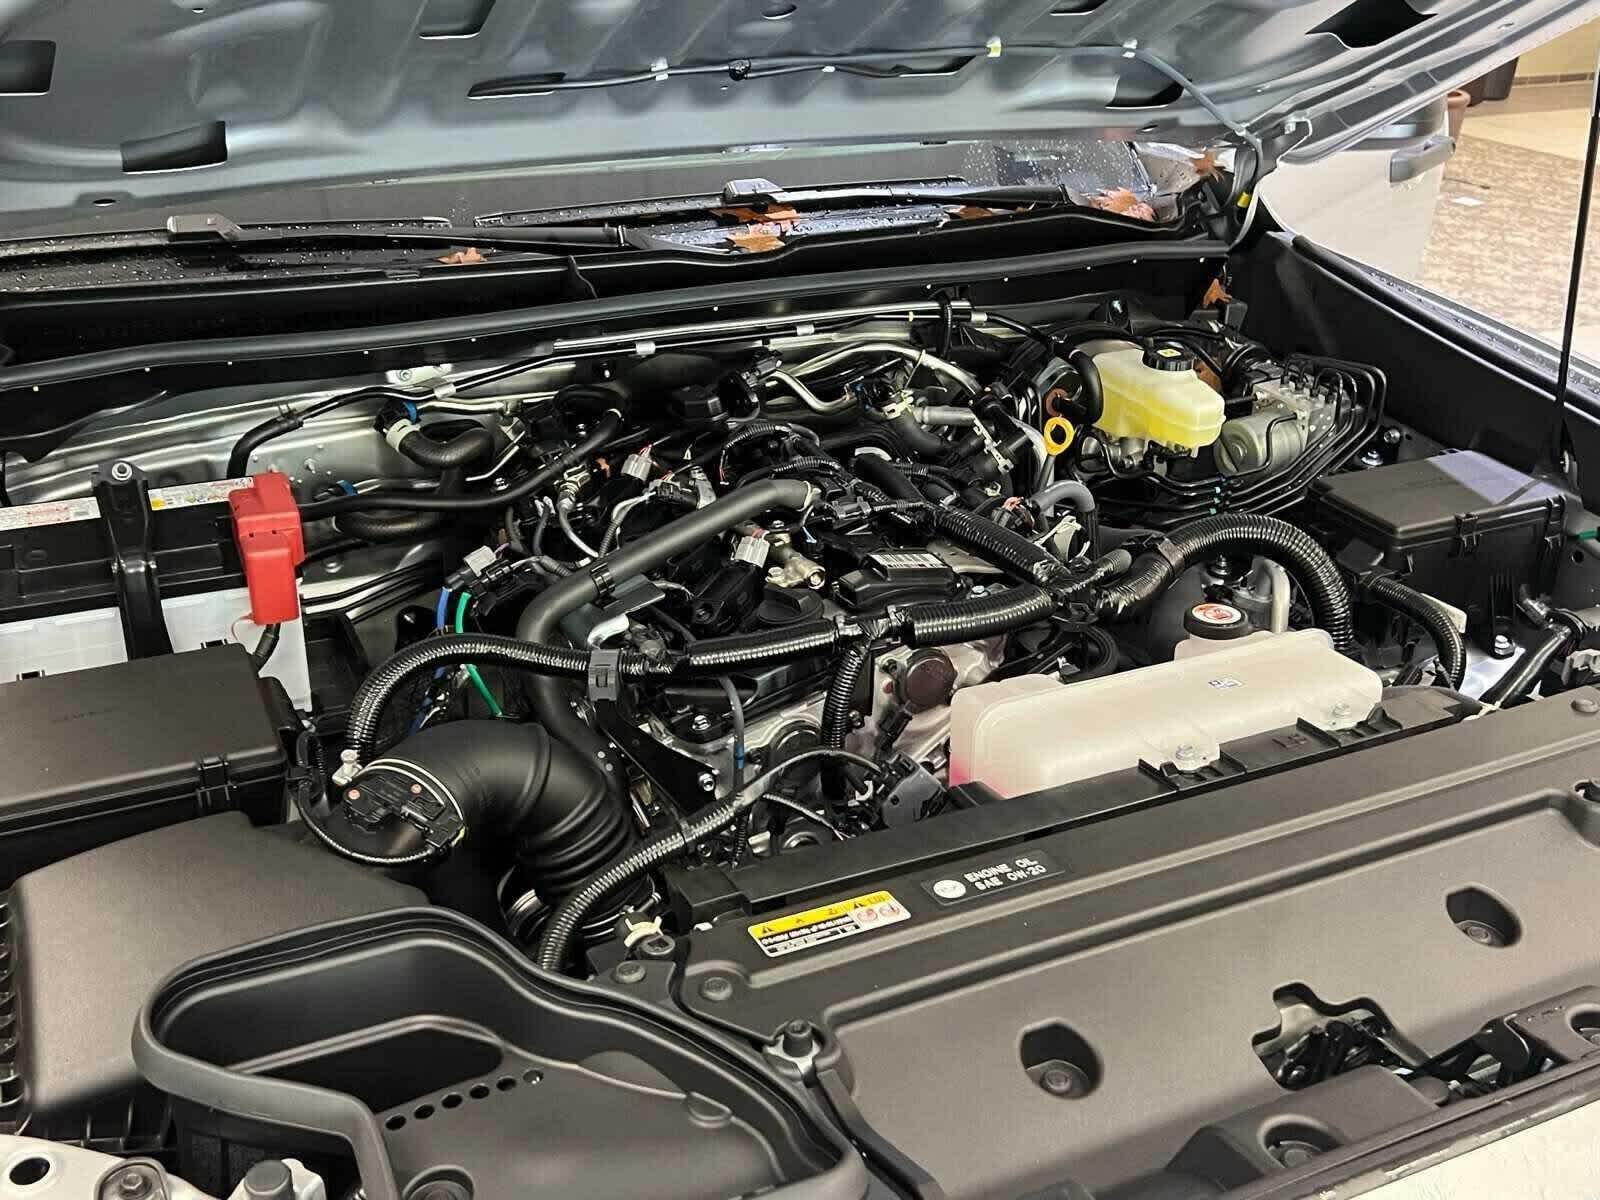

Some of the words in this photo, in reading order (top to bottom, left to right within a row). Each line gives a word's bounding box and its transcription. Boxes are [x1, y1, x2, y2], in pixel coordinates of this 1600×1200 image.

[963, 863, 1012, 883] ENGINE
[1015, 857, 1039, 868] OIL
[974, 876, 1004, 891] SAE
[1006, 864, 1047, 881] 0W-20
